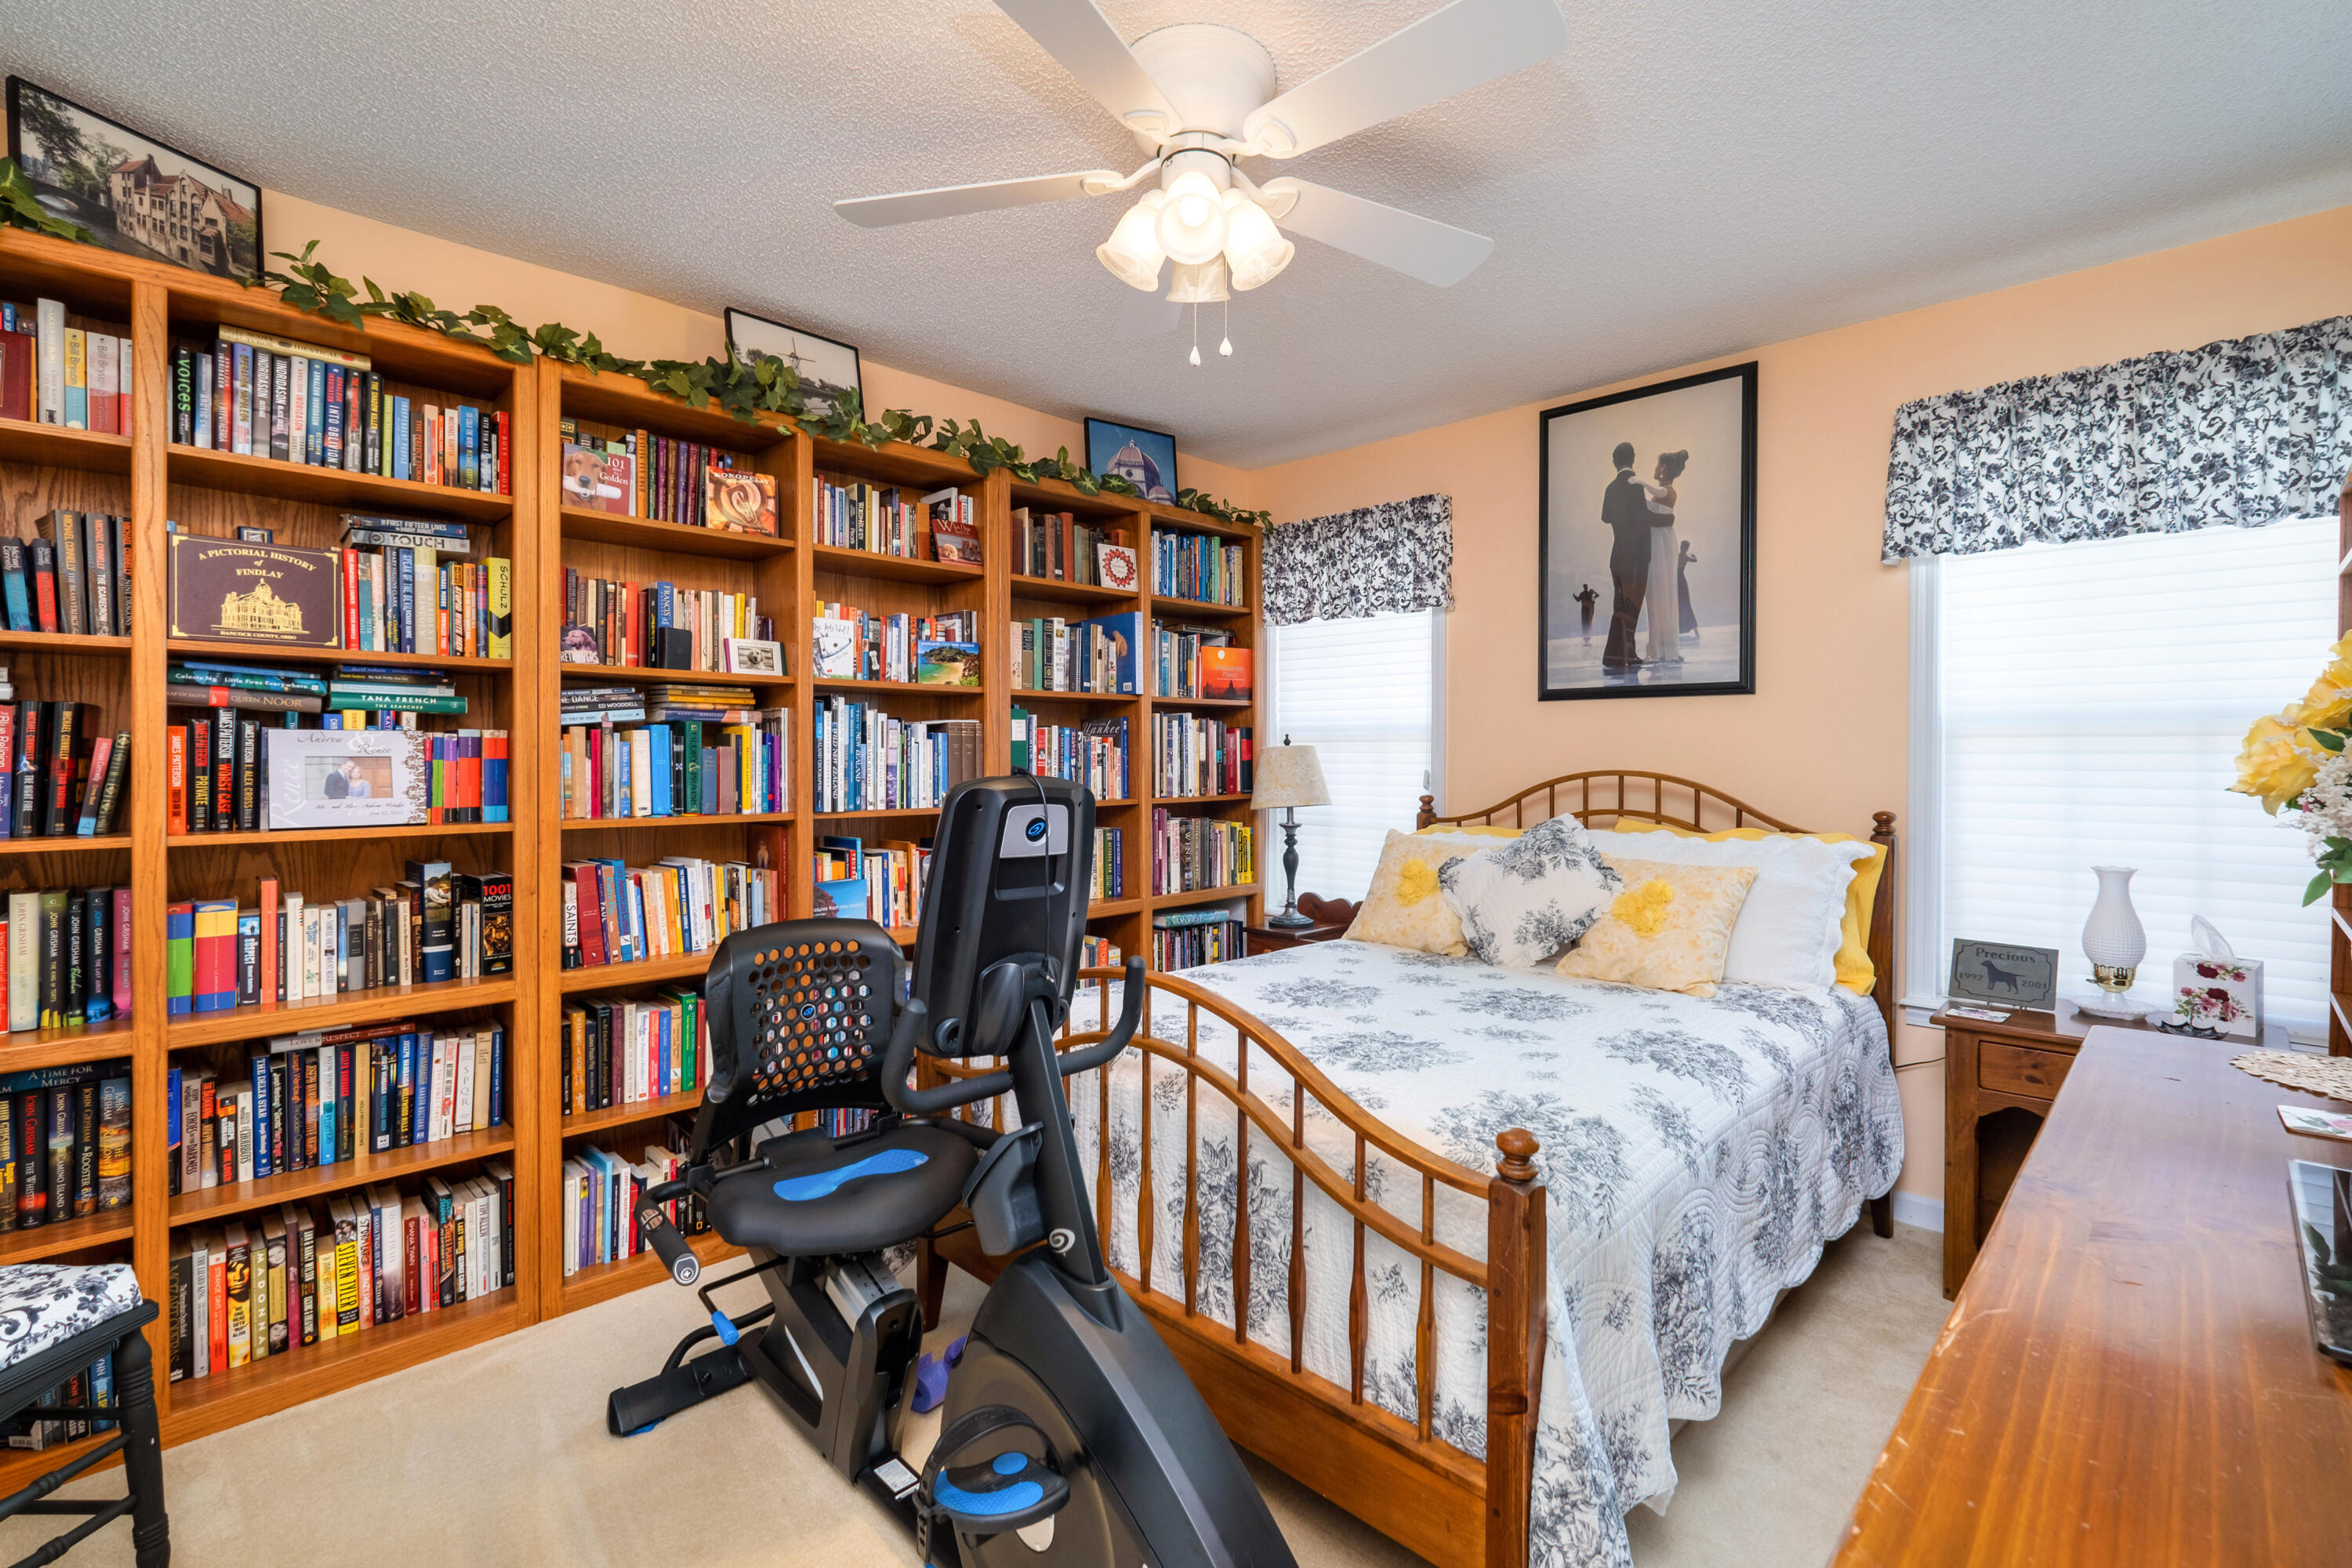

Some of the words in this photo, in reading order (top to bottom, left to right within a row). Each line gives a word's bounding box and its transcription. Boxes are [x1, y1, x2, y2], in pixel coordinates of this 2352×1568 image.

[69, 341, 83, 356] Bill
[99, 345, 108, 359] Bill
[68, 356, 83, 385] Bryson
[97, 360, 108, 388] Bryson
[329, 405, 339, 424] INTO
[328, 426, 339, 463] OBLIVION
[607, 457, 625, 470] 101
[599, 472, 628, 485] Golden
[390, 535, 445, 548] TOUCH
[207, 548, 268, 558] PICTORIAL
[270, 552, 317, 572] HISTORY
[403, 554, 412, 573] SPEAK
[97, 574, 106, 585] THE
[235, 568, 284, 579] FINDLAY
[403, 583, 412, 593] THE
[97, 586, 108, 622] SCARECROW
[403, 595, 412, 611] DEVIL
[231, 695, 261, 704] QUEEN
[263, 696, 303, 708] NOOR
[27, 710, 38, 732] MICHAEL
[61, 710, 72, 732] MICHAEL
[220, 710, 233, 728] JAMES
[59, 734, 71, 760] CONNELLY
[172, 735, 181, 753] JAMES
[195, 739, 208, 767] PATTERSON
[219, 729, 232, 758] PATTERSON
[24, 775, 34, 785] THE
[172, 755, 181, 787] PATTERSON
[218, 764, 231, 790] WORST
[244, 771, 254, 786] ALEX
[24, 785, 34, 800] NIGHT
[196, 775, 209, 806] PRIVATE
[244, 787, 253, 808] CROSS
[23, 800, 34, 812] FIRE
[217, 793, 231, 814] CASE
[483, 884, 511, 895] 1001
[483, 894, 511, 902] MOVIES
[606, 877, 615, 900] Padre
[18, 902, 27, 922] JOHN
[50, 911, 59, 928] JOHN
[71, 916, 80, 934] JOHN
[565, 905, 577, 944] SAINTS
[17, 923, 27, 956] GRISHAM
[49, 929, 58, 957] GRISHAM
[122, 924, 130, 950] GRISHAM
[71, 935, 80, 965] GRISHAM
[1975, 946, 2037, 964] Precious
[1959, 971, 1983, 982] 1992
[2020, 979, 2048, 990] 2001
[322, 1031, 360, 1042] RESPECT
[28, 1072, 38, 1080] A
[42, 1069, 68, 1079] TIME
[71, 1065, 93, 1075] FOR
[42, 1076, 82, 1088] MERCY
[83, 1087, 95, 1107] JOHN
[258, 1076, 267, 1098] DELTA
[25, 1095, 38, 1116] JOHN
[56, 1093, 66, 1112] JOHN
[103, 1086, 114, 1120] GRISHAM
[115, 1091, 126, 1112] JOHN
[258, 1099, 267, 1118] STAR
[56, 1112, 67, 1142] GRISHAM
[82, 1109, 94, 1142] GRISHAM
[187, 1112, 197, 1133] ECHOES
[25, 1118, 38, 1155] GRISHAM
[240, 1129, 251, 1163] CHOIRBOYS
[114, 1145, 124, 1158] THE
[187, 1144, 198, 1174] DARKNESS
[26, 1161, 34, 1175] THE
[56, 1153, 67, 1183] CAMINO
[81, 1151, 93, 1186] ROOSTER
[25, 1175, 37, 1210] WHISTLER
[56, 1183, 67, 1208] ISLAND
[81, 1185, 92, 1204] BAR
[480, 1204, 488, 1217] TIM
[479, 1218, 488, 1238] ALLEN
[338, 1245, 354, 1280] STEVEN
[257, 1253, 267, 1345] MADONNA
[339, 1280, 357, 1308] TYLER
